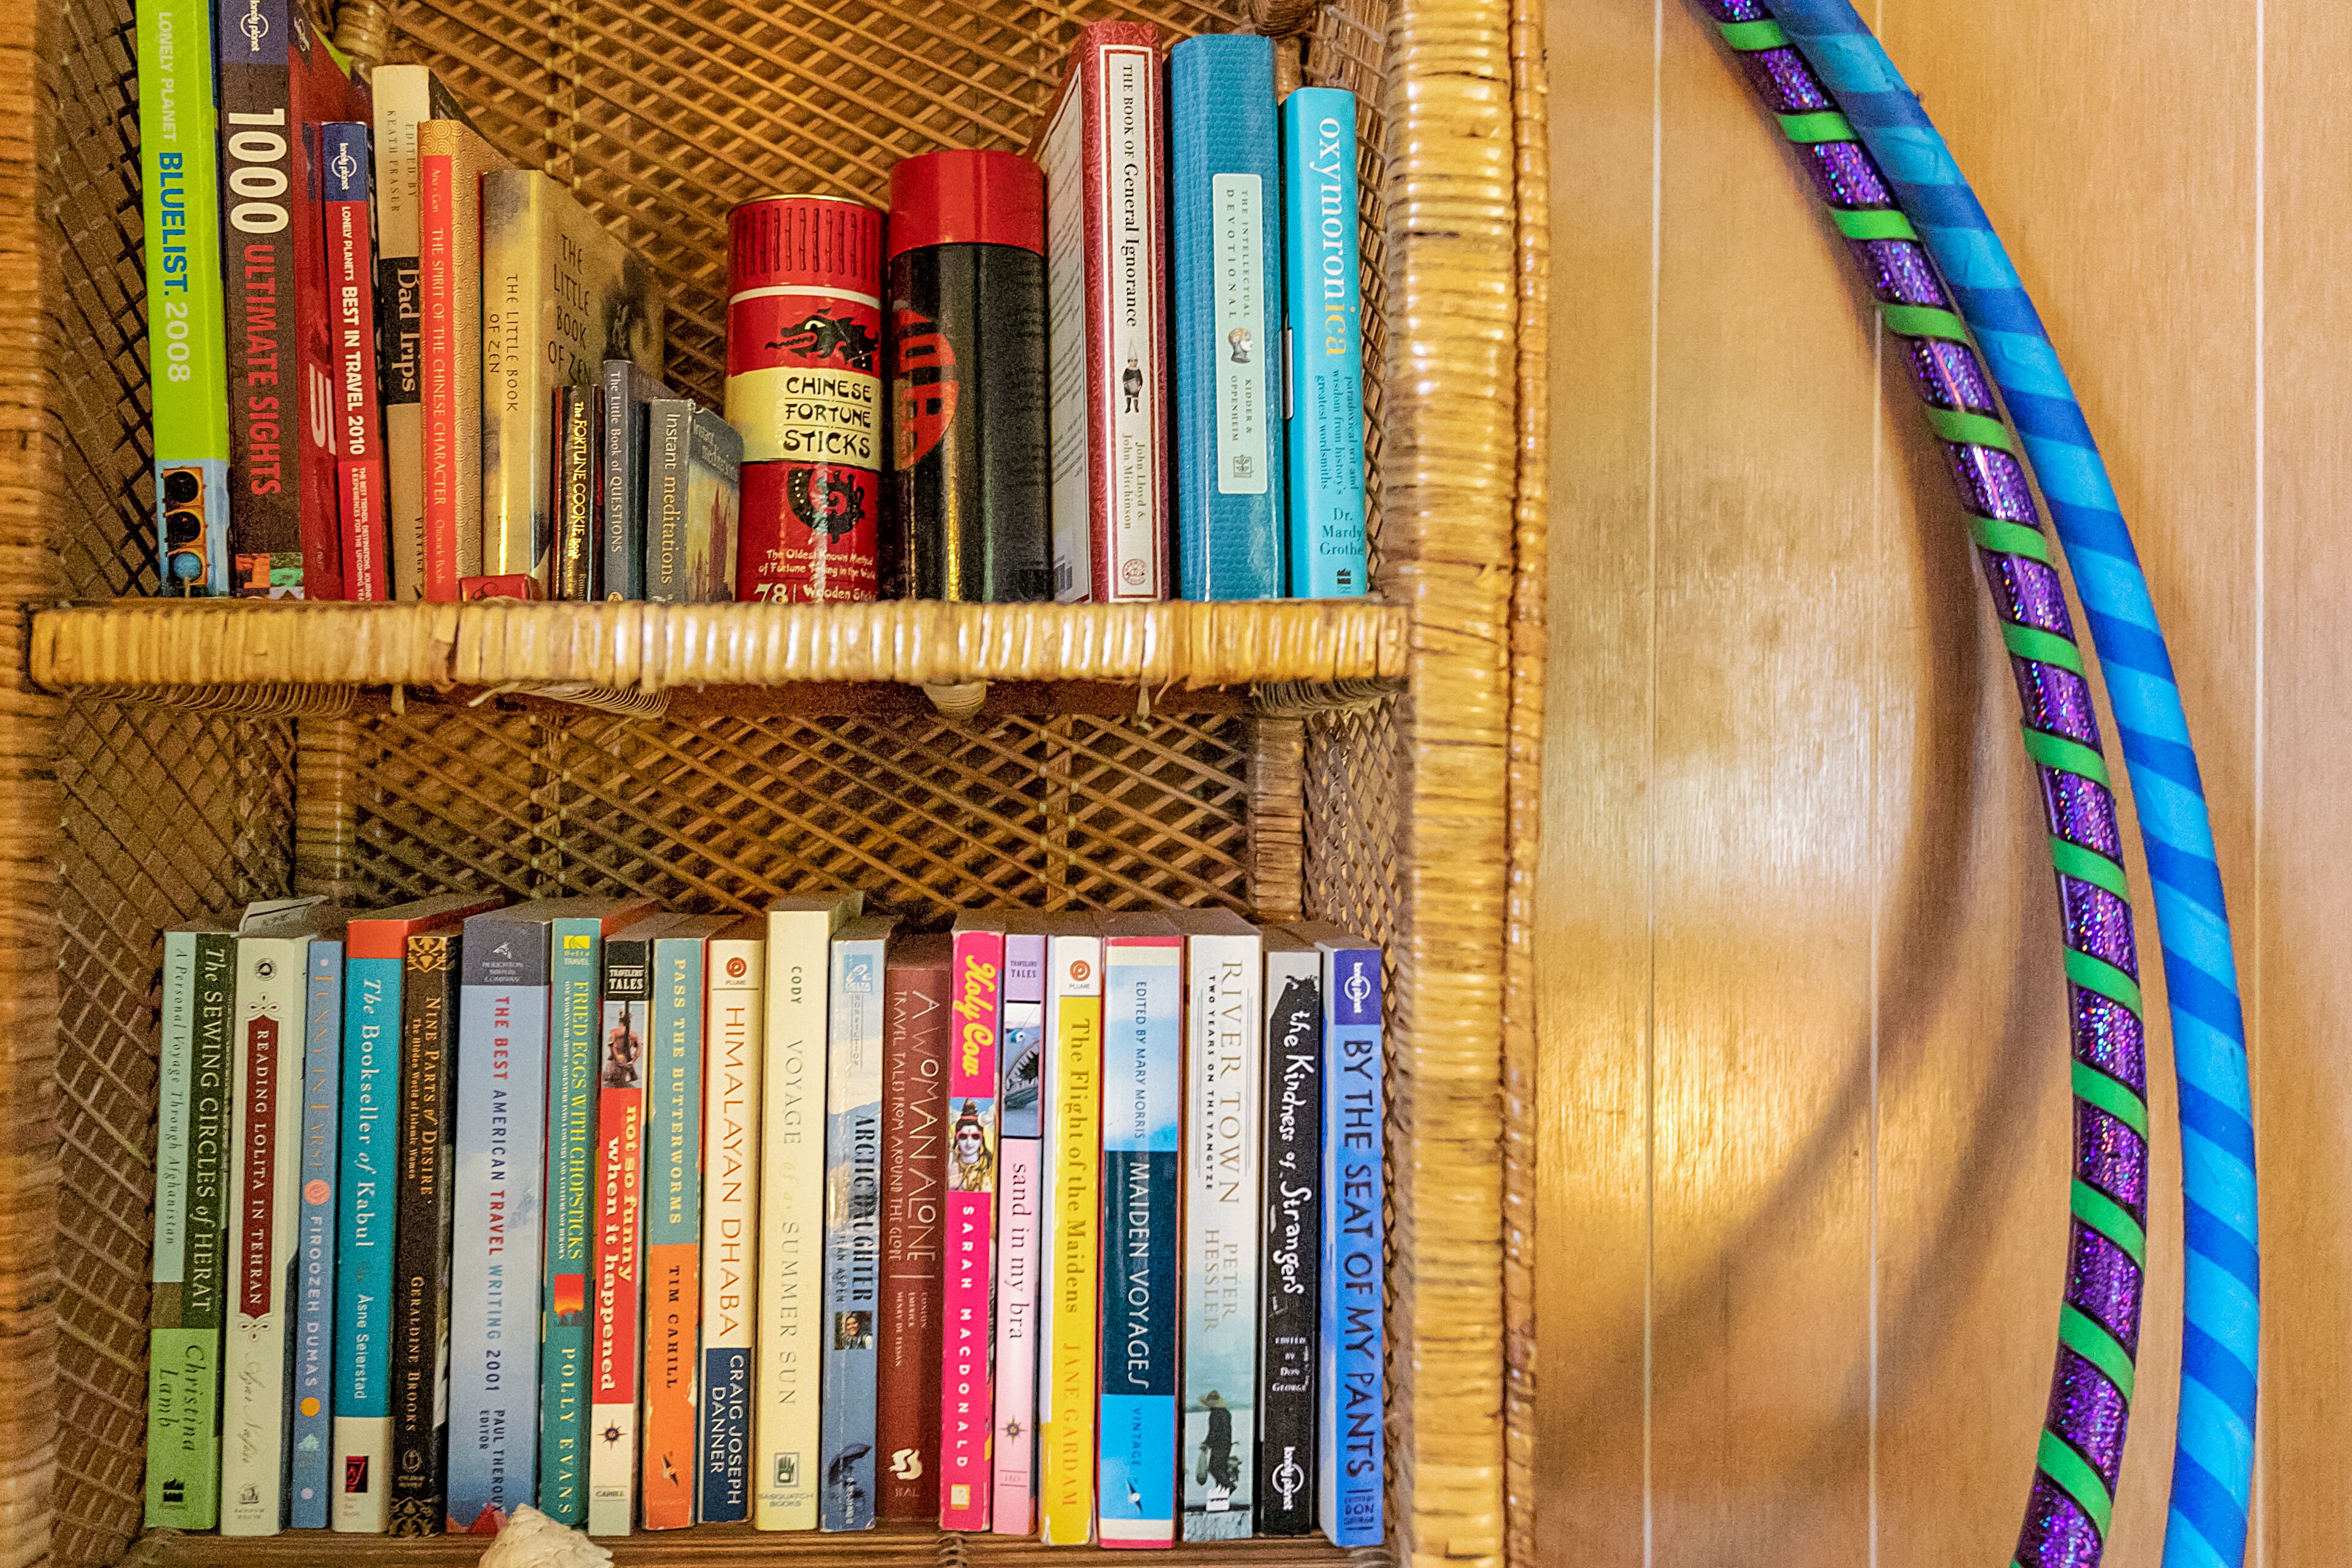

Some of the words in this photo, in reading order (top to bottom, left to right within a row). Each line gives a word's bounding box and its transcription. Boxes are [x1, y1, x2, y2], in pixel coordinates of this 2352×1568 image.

[159, 12, 173, 72] LONELY
[249, 25, 260, 51] planet
[1122, 64, 1133, 91] THE
[161, 78, 176, 141] PLANET
[1123, 97, 1134, 134] BOOK
[228, 108, 288, 233] 1000
[1124, 140, 1134, 159] OF
[341, 206, 352, 238] LONELY
[1124, 163, 1139, 232] General
[431, 228, 444, 255] THE
[1227, 189, 1237, 318] DEVOTIONAL
[1310, 118, 1355, 356] oxymoronica
[432, 261, 445, 297] SPIRIT
[506, 274, 518, 303] THE
[554, 264, 589, 317] LITTLE
[1120, 239, 1140, 326] Ignorance
[244, 245, 277, 386] ULTIMATE
[342, 287, 359, 325] BEST
[432, 304, 445, 318] OF
[488, 314, 500, 333] OF
[557, 306, 587, 350] BOOK
[165, 302, 191, 382] 2008
[344, 330, 360, 347] IN
[433, 328, 445, 355] THE
[488, 341, 500, 373] ZEN
[506, 312, 519, 361] LITTLE
[345, 351, 363, 411] TRAVEL
[433, 360, 447, 418] CHINESE
[506, 369, 519, 412] BOOK
[609, 372, 621, 391] The
[786, 377, 872, 403] CHINESE
[1315, 375, 1328, 420] greatest
[1332, 370, 1344, 413] wisdom
[348, 416, 366, 455] 2010
[610, 396, 621, 424] Little
[785, 403, 871, 428] FORTUNE
[1333, 417, 1344, 442] from
[1344, 375, 1358, 443] paradoxical
[248, 396, 281, 495] SIGHTS
[433, 423, 447, 505] CHARACTER
[611, 429, 622, 456] Book
[611, 461, 622, 473] of
[663, 414, 680, 470] Instant
[783, 429, 870, 459] STICKS
[1122, 433, 1132, 461] John
[1319, 425, 1333, 490] wordsmiths
[1349, 447, 1359, 464] wit
[1123, 466, 1133, 529] Mitchinson
[1335, 447, 1347, 495] history's
[1351, 469, 1360, 491] and
[609, 476, 623, 552] QUESTIONS
[661, 476, 681, 584] meditations
[1322, 525, 1363, 542] Mardy
[1333, 508, 1353, 521] Dr.
[766, 549, 783, 560] The
[205, 949, 227, 982] The
[609, 979, 643, 990] TALES
[673, 959, 687, 1008] PASS
[952, 956, 997, 1022] Holy
[1011, 969, 1037, 979] TALES
[363, 979, 382, 1014] The
[494, 997, 510, 1029] THE
[573, 981, 589, 1036] FRIED
[911, 990, 941, 1020] A
[1136, 981, 1147, 1025] EDITED
[1220, 961, 1243, 1079] RIVER
[200, 990, 223, 1088] SEWING
[671, 1017, 686, 1058] THE
[962, 1023, 995, 1078] Cow
[1070, 1017, 1090, 1063] The
[1136, 1030, 1147, 1044] BY
[1283, 1011, 1311, 1047] the
[254, 1030, 270, 1114] READING
[358, 1025, 380, 1145] Bookseller
[493, 1038, 508, 1080] BEST
[571, 1042, 588, 1089] EGGS
[1135, 1049, 1147, 1086] MARY
[1207, 1064, 1215, 1082] ON
[1344, 1040, 1373, 1081] BY
[569, 1095, 588, 1142] WITH
[722, 1008, 745, 1203] HIMALAYAN
[909, 1027, 940, 1159] WOMAN
[1065, 1071, 1089, 1139] Flight
[1134, 1090, 1146, 1139] MORRIS
[1278, 1054, 1315, 1142] Kindness
[1344, 1089, 1374, 1148] THE
[197, 1096, 219, 1197] CIRCLES
[491, 1090, 507, 1180] AMERICAN
[625, 1105, 639, 1152] not
[669, 1068, 685, 1224] BUTTERWORMS
[1218, 1092, 1240, 1204] TOWN
[253, 1123, 267, 1190] LOLITA
[354, 1152, 377, 1175] of
[607, 1137, 621, 1216] when
[624, 1158, 636, 1189] so
[1068, 1147, 1087, 1172] of
[1205, 1123, 1213, 1190] YANGTZE
[1278, 1152, 1296, 1170] of
[189, 1205, 215, 1227] of
[252, 1200, 265, 1219] IN
[355, 1182, 376, 1247] Kabul
[567, 1147, 586, 1260] CHOPSTICKS
[906, 1166, 938, 1262] ALONE
[1012, 1163, 1032, 1216] sand
[1067, 1176, 1087, 1212] the
[1129, 1162, 1150, 1257] MAIDEN
[1343, 1163, 1374, 1238] SEAT
[488, 1191, 505, 1256] TRAVEL
[605, 1224, 620, 1246] it
[618, 1196, 638, 1284] funny
[960, 1205, 975, 1289] SARAH
[1011, 1227, 1030, 1248] in
[1272, 1181, 1313, 1294] Strangers
[192, 1232, 214, 1312] HERAT
[249, 1229, 265, 1304] TEHRAN
[668, 1265, 680, 1303] TIM
[720, 1218, 742, 1336] DHABA
[1004, 1257, 1025, 1292] my
[1066, 1219, 1086, 1313] Maidens
[1204, 1230, 1219, 1332] HESSLER
[1223, 1243, 1238, 1317] PETER
[1343, 1253, 1374, 1295] OF
[486, 1265, 503, 1340] WRITING
[600, 1254, 620, 1391] happened
[1009, 1302, 1030, 1339] bra
[1128, 1268, 1150, 1389] VOYAGES
[665, 1314, 680, 1389] CAHILL
[1344, 1306, 1376, 1360] MY
[485, 1350, 501, 1390] 2001
[560, 1349, 576, 1423] POLLY
[729, 1354, 745, 1420] CRAIG
[956, 1308, 973, 1467] MACDONALD
[1063, 1342, 1080, 1400] JANE
[492, 1410, 505, 1442] PAUL
[710, 1387, 727, 1474] DANNER
[1131, 1407, 1142, 1466] VINTAGE
[1344, 1372, 1375, 1477] PANTS
[491, 1450, 505, 1513] THEROUX
[558, 1439, 574, 1515] EVANS
[726, 1426, 744, 1505] JOSEPH
[1062, 1409, 1079, 1506] GARDAM
